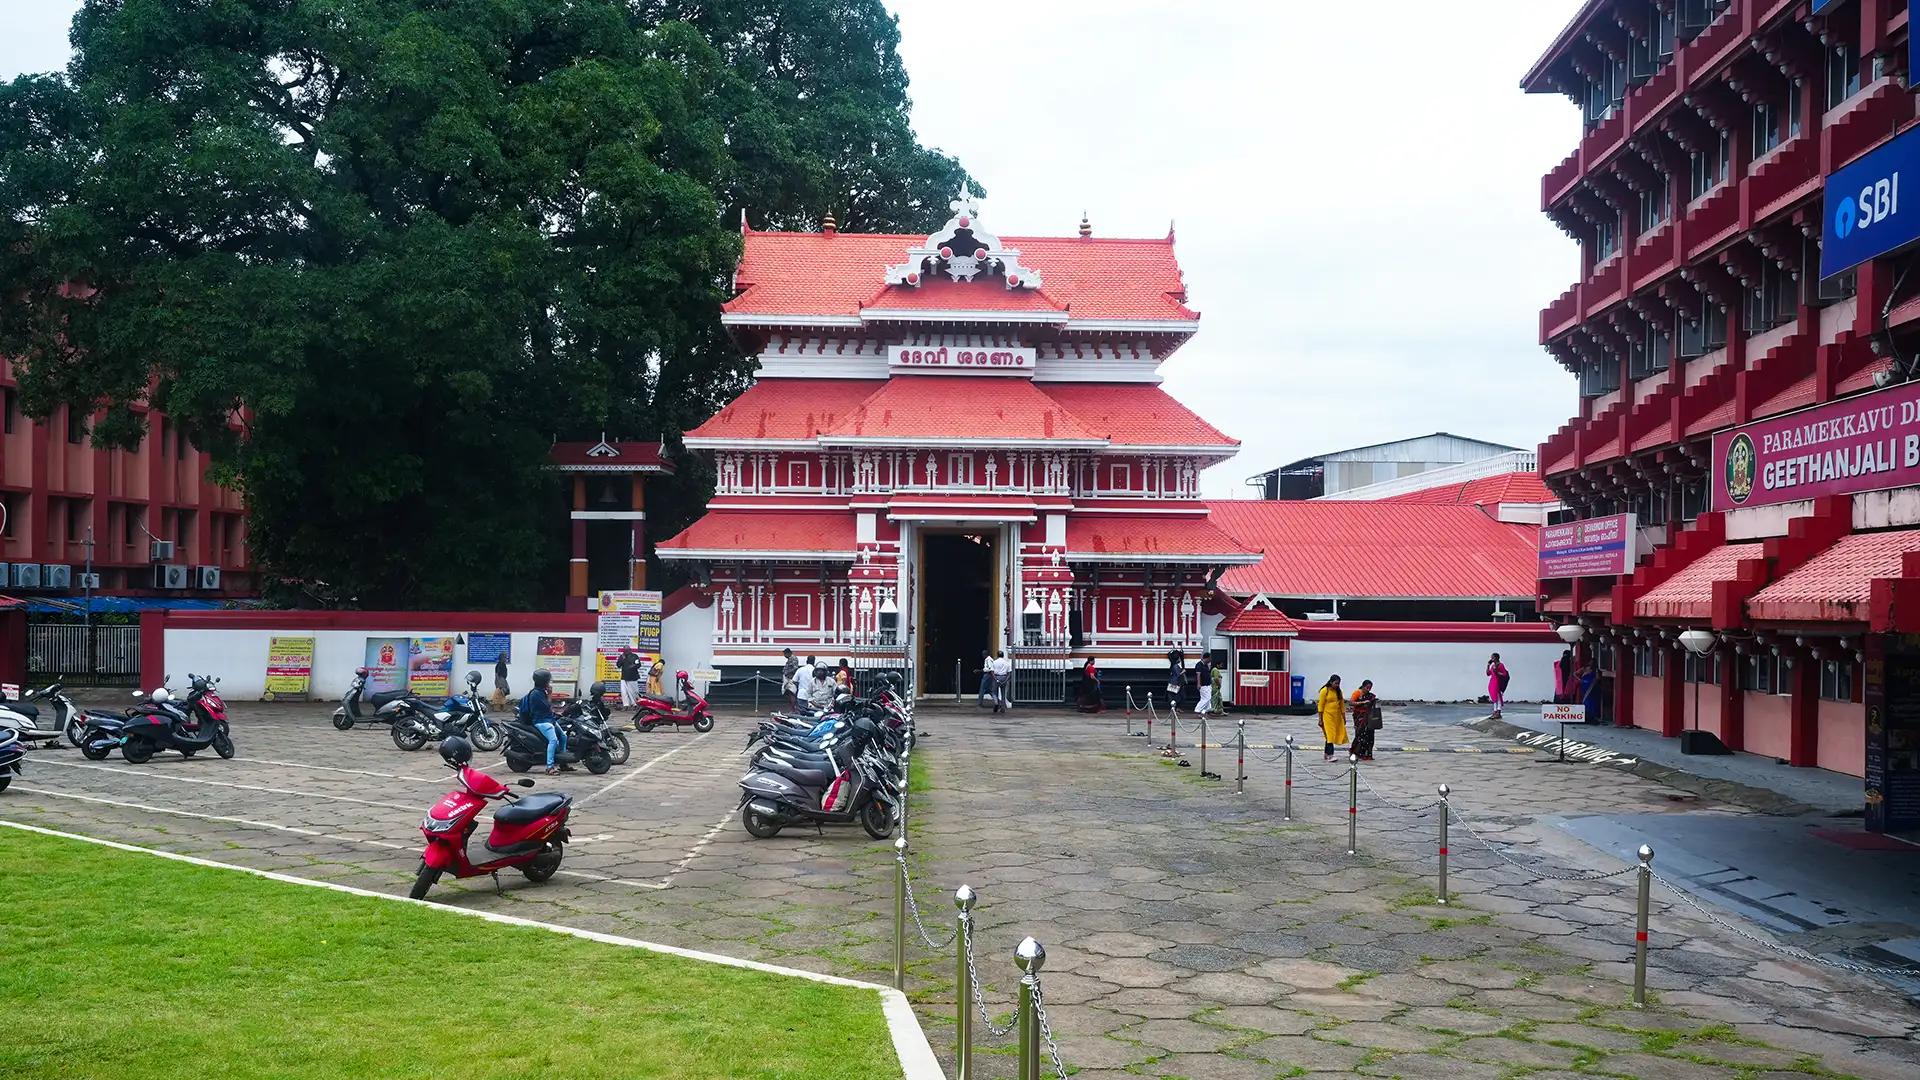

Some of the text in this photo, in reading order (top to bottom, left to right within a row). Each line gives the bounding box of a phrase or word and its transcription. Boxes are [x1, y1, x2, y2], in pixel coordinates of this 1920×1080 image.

[1857, 171, 1899, 229] SBI
[957, 351, 1024, 365] ശരണം
[1762, 405, 1895, 455] PARAMEKKAVU
[1762, 438, 1897, 491] GEETHANJALI
[640, 627, 660, 637] FYUGP
[1543, 738, 1620, 764] PARKING
[448, 802, 474, 818] electric
